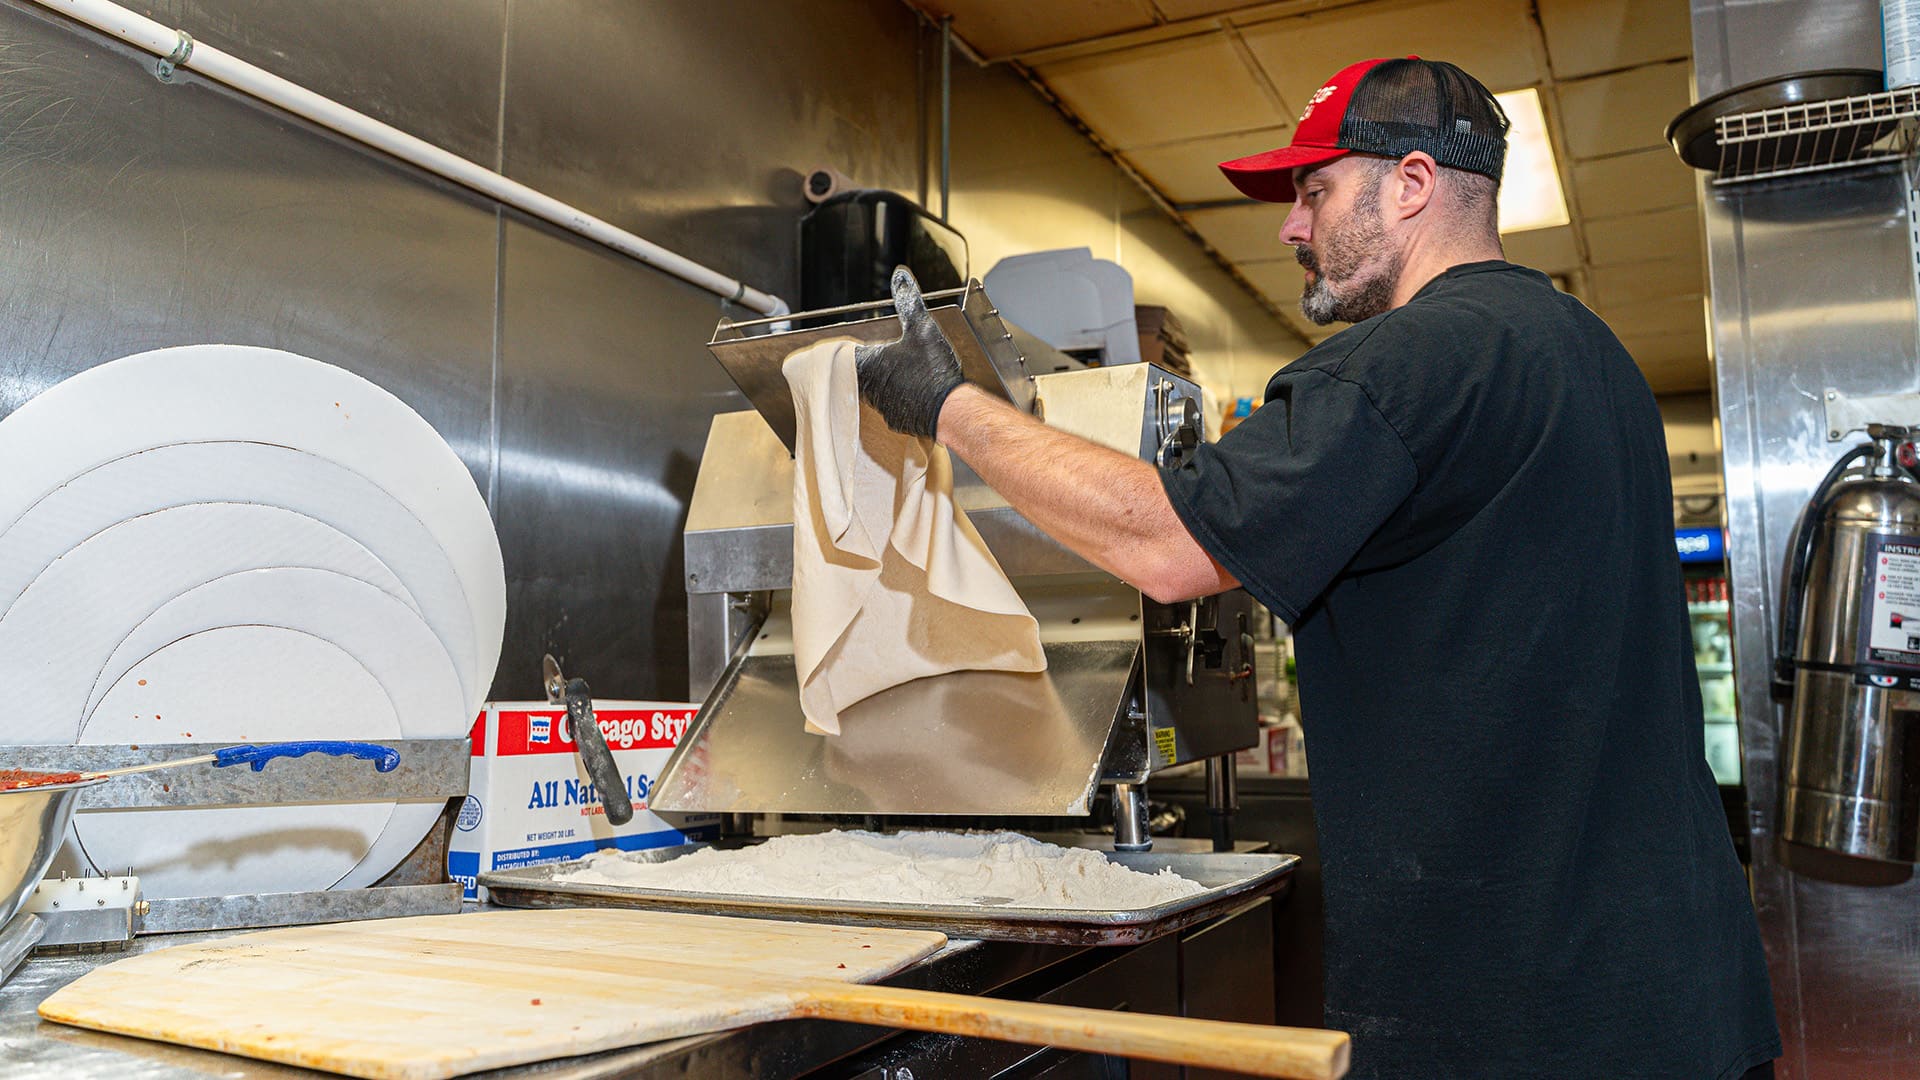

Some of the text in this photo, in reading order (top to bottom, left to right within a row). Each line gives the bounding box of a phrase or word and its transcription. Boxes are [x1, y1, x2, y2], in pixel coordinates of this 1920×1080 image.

[558, 712, 693, 749] Ccago Styl
[528, 780, 558, 809] All
[564, 775, 632, 806] Natl
[592, 806, 605, 815] LABE
[527, 833, 536, 842] NET
[538, 831, 557, 840] WEIGHT
[496, 850, 530, 861] DISTRIBUTED
